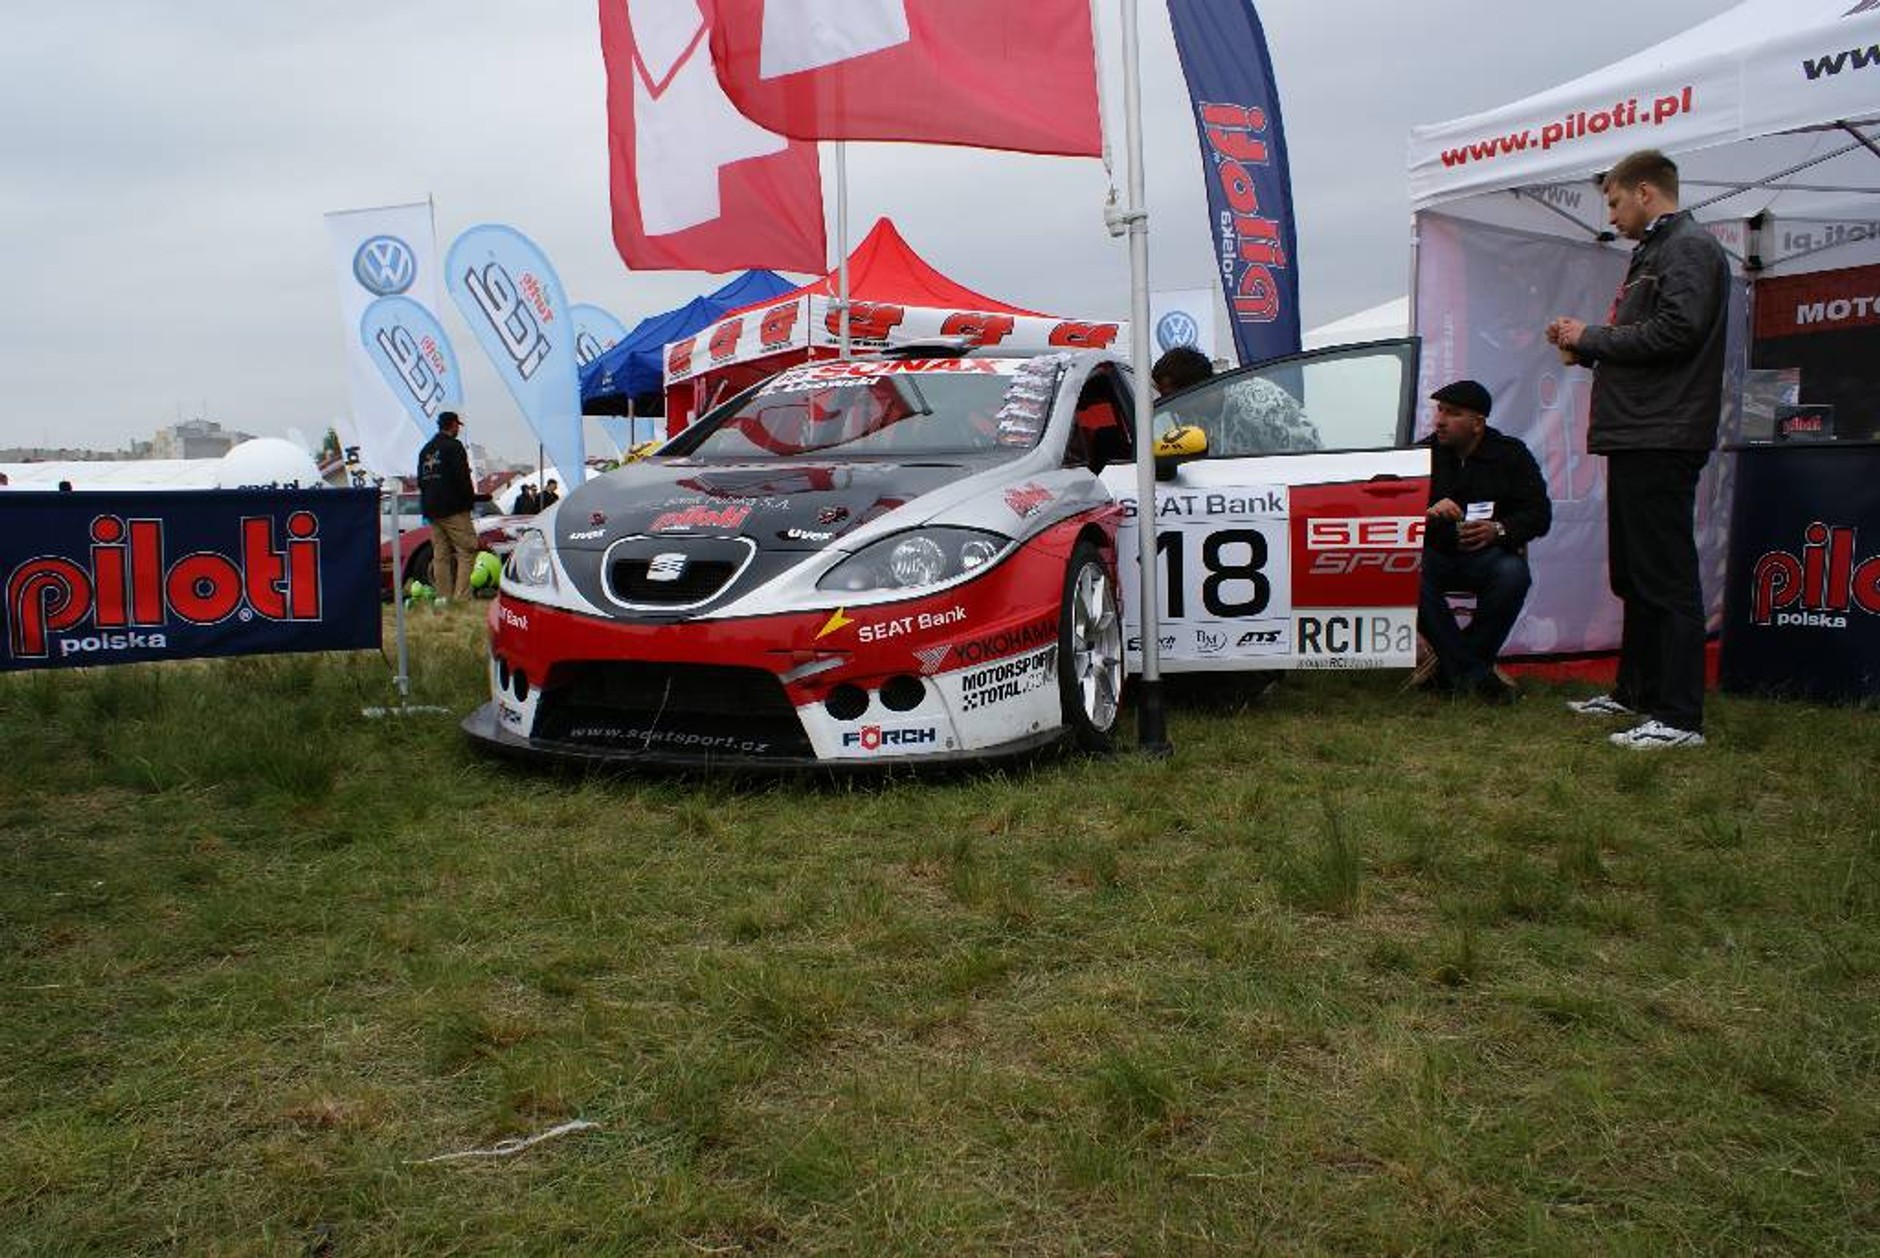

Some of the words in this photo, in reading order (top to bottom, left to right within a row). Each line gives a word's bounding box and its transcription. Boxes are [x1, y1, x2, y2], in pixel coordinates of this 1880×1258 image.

[1441, 86, 1693, 167] www.piloti.pl
[812, 358, 998, 378] SONAX
[1119, 495, 1198, 518] SAT
[1206, 491, 1284, 515] Bank
[1137, 528, 1271, 619] 18
[1309, 552, 1424, 575] SPO
[5, 510, 322, 660] piloti
[859, 613, 914, 643] SEAT
[918, 605, 967, 630] Bank
[1777, 611, 1848, 628] polska
[60, 632, 166, 657] polska
[1299, 616, 1363, 654] RCI
[570, 726, 770, 753] www.seatsport.cz
